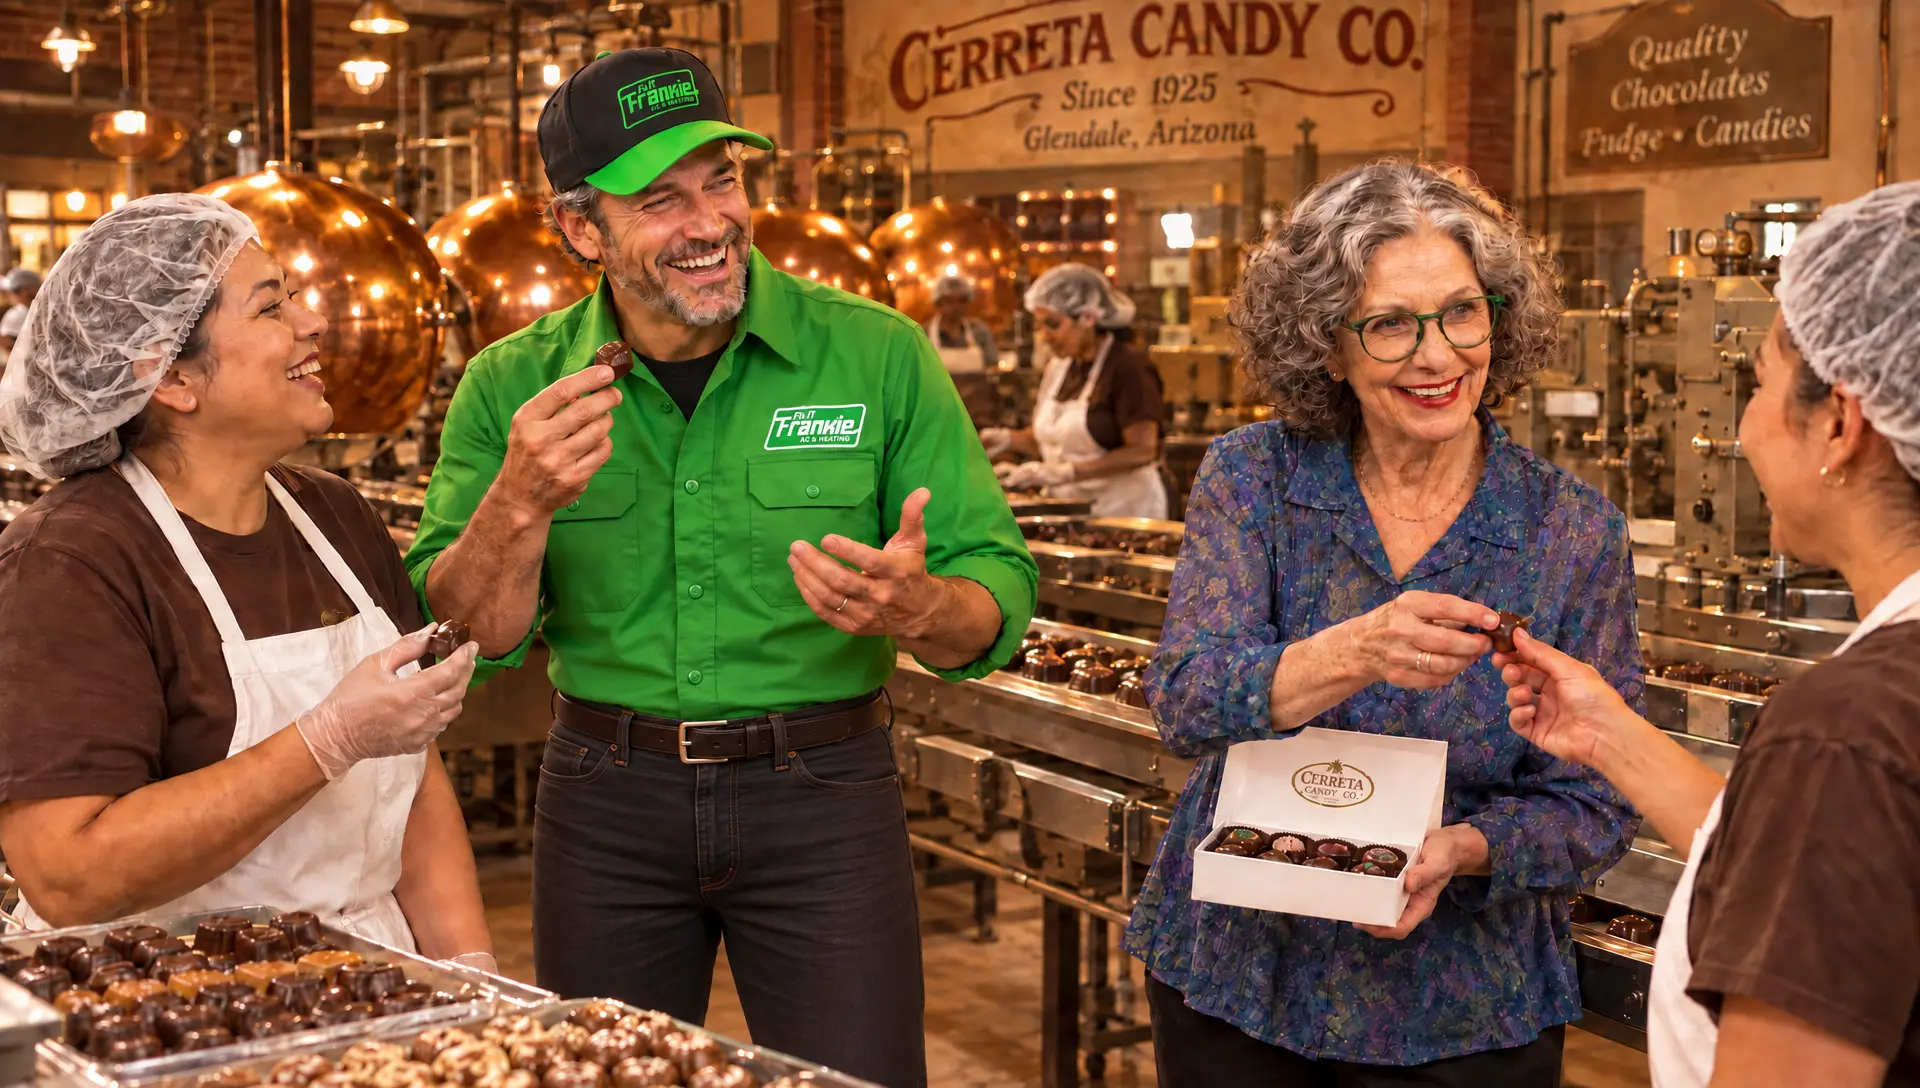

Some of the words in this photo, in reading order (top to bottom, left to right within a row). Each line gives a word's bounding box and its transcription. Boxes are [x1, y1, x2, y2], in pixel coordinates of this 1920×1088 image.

[889, 12, 1115, 112] CERRETA
[1130, 1, 1320, 59] CANDY
[1338, 5, 1424, 72] CO.
[1629, 22, 1748, 71] Quality
[1061, 79, 1137, 111] Since
[1151, 72, 1218, 106] 1925
[1610, 66, 1770, 111] Chocolates
[1024, 119, 1139, 151] Glendale,
[1146, 117, 1257, 146] Arizona
[1695, 106, 1812, 148] Candies
[774, 415, 858, 438] Frankie
[1301, 770, 1364, 791] CERRETA
[1304, 785, 1338, 797] CANDY
[1342, 790, 1359, 800] CO.
